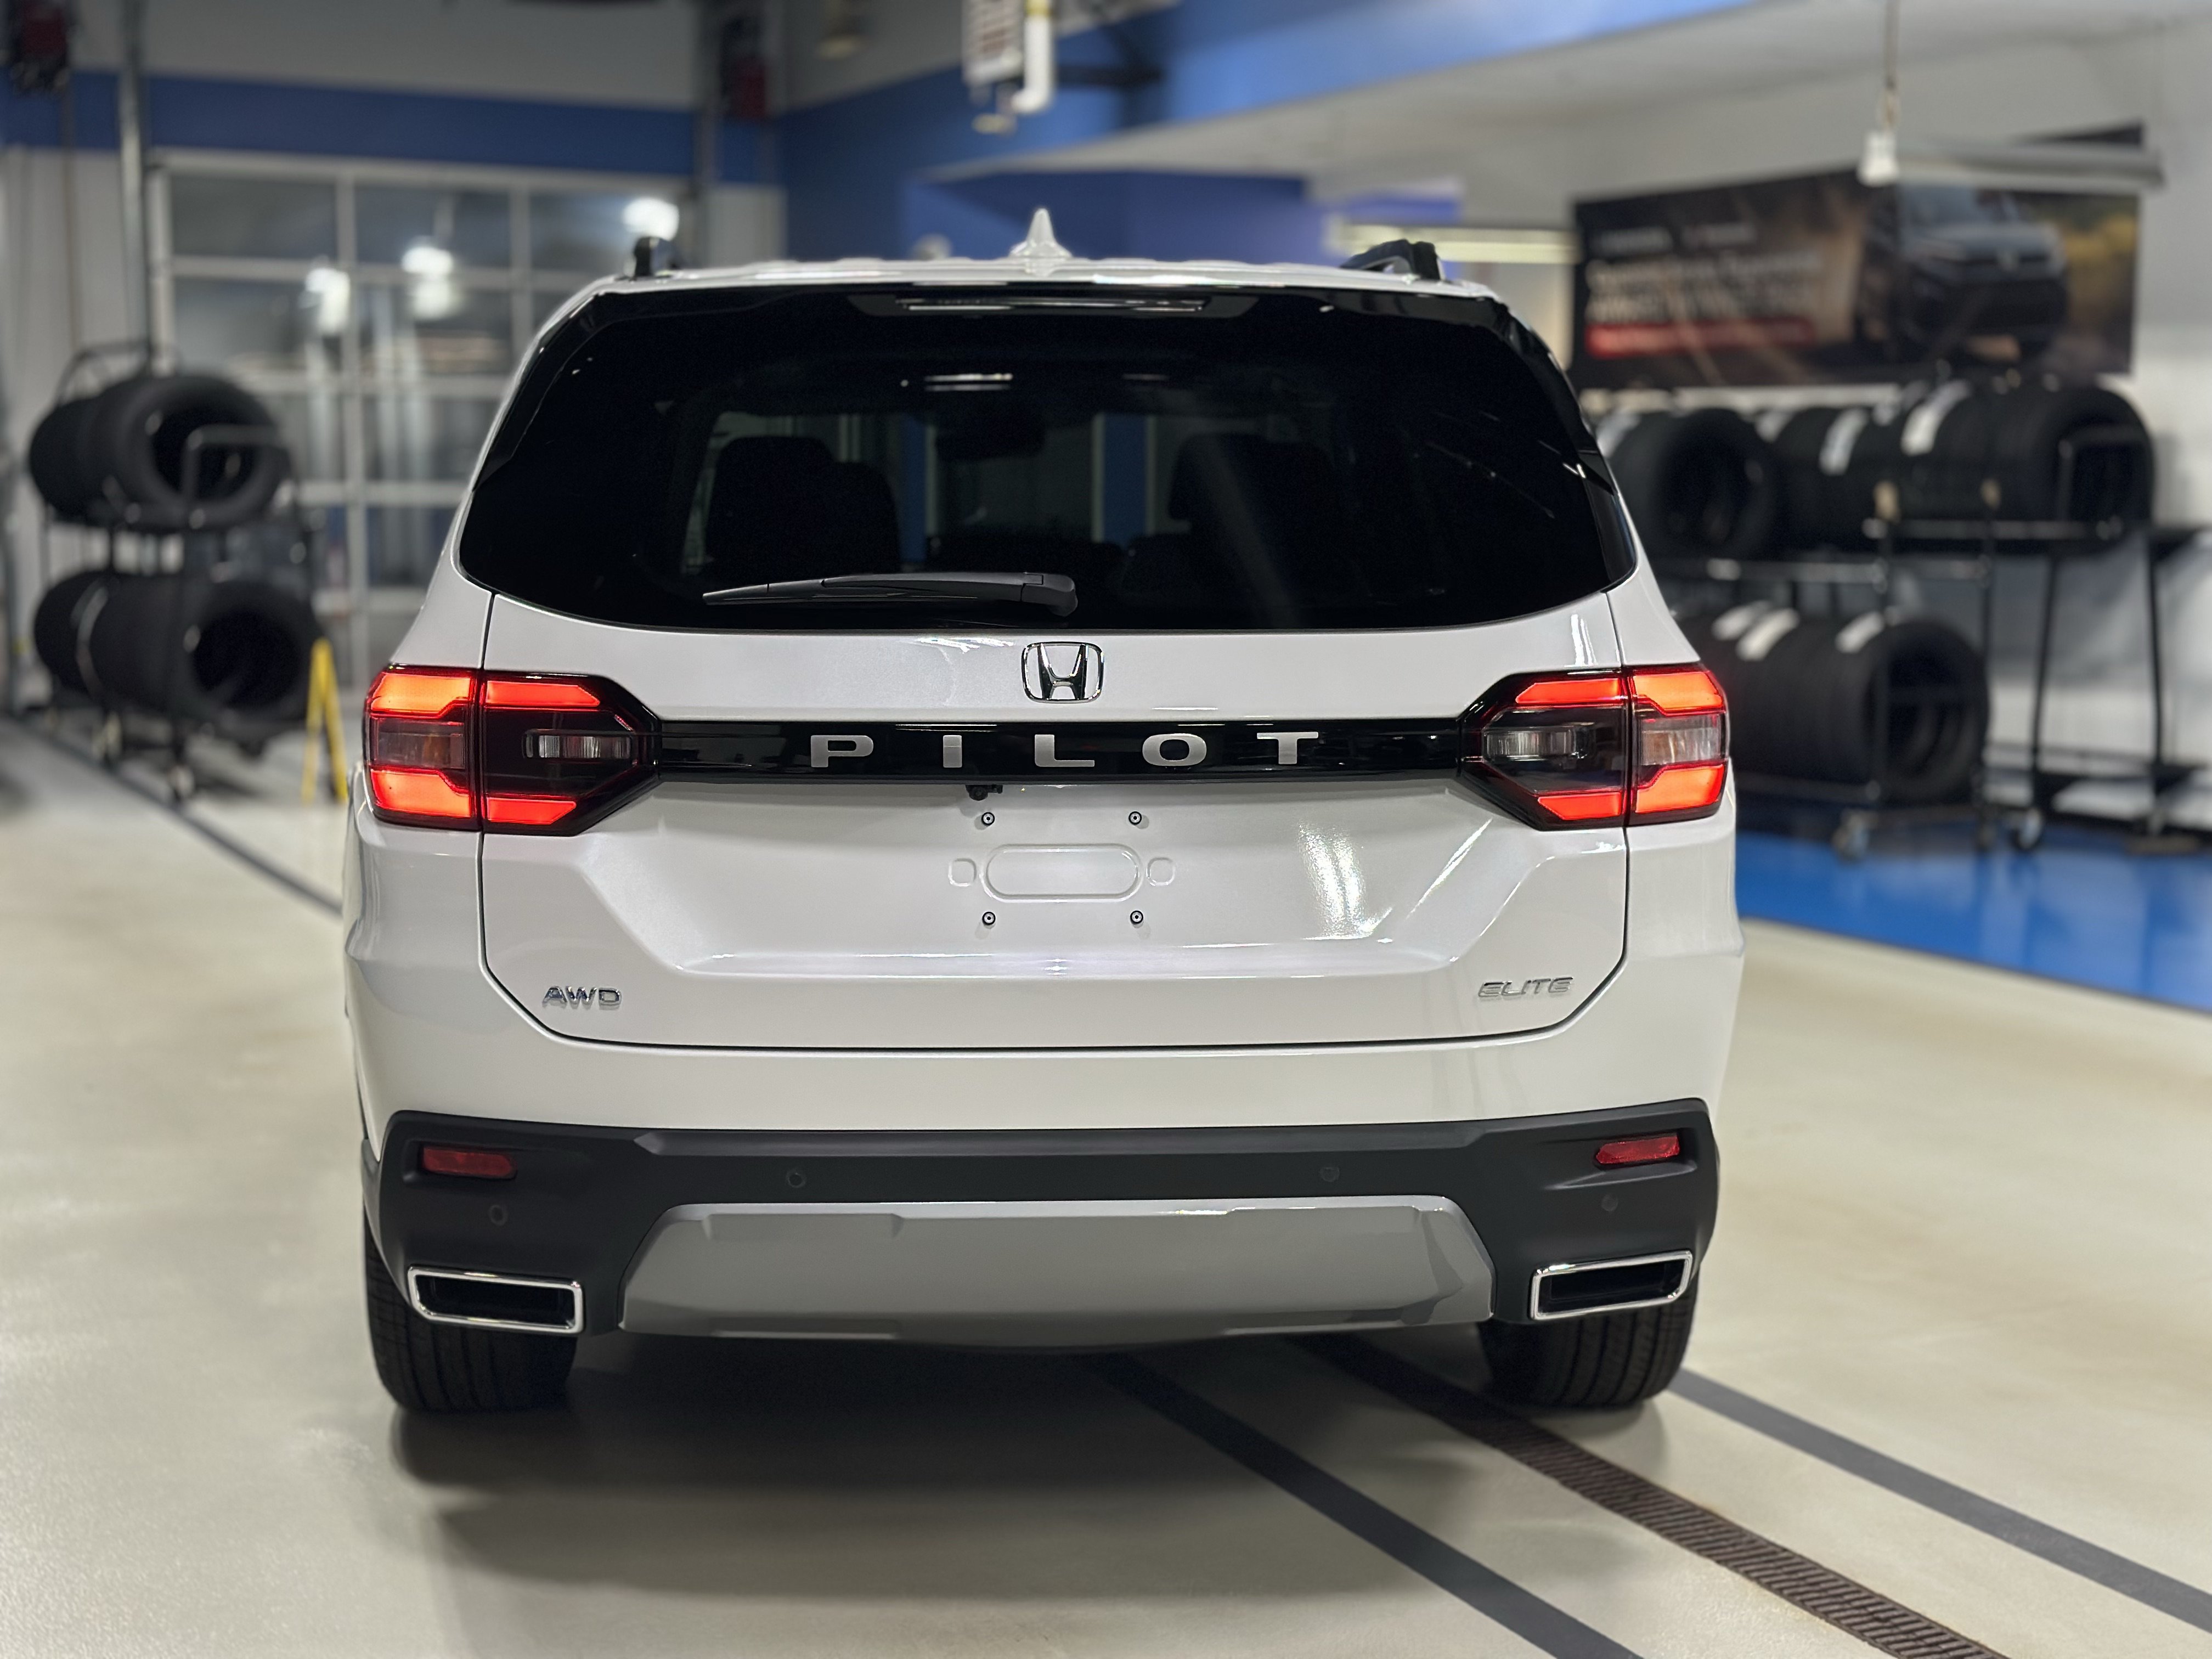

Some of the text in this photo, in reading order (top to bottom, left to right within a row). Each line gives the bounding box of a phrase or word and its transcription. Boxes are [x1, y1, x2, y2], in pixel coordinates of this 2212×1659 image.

[810, 731, 1319, 768] PILOT
[542, 986, 622, 1009] AWD
[1478, 977, 1573, 997] ELITE
